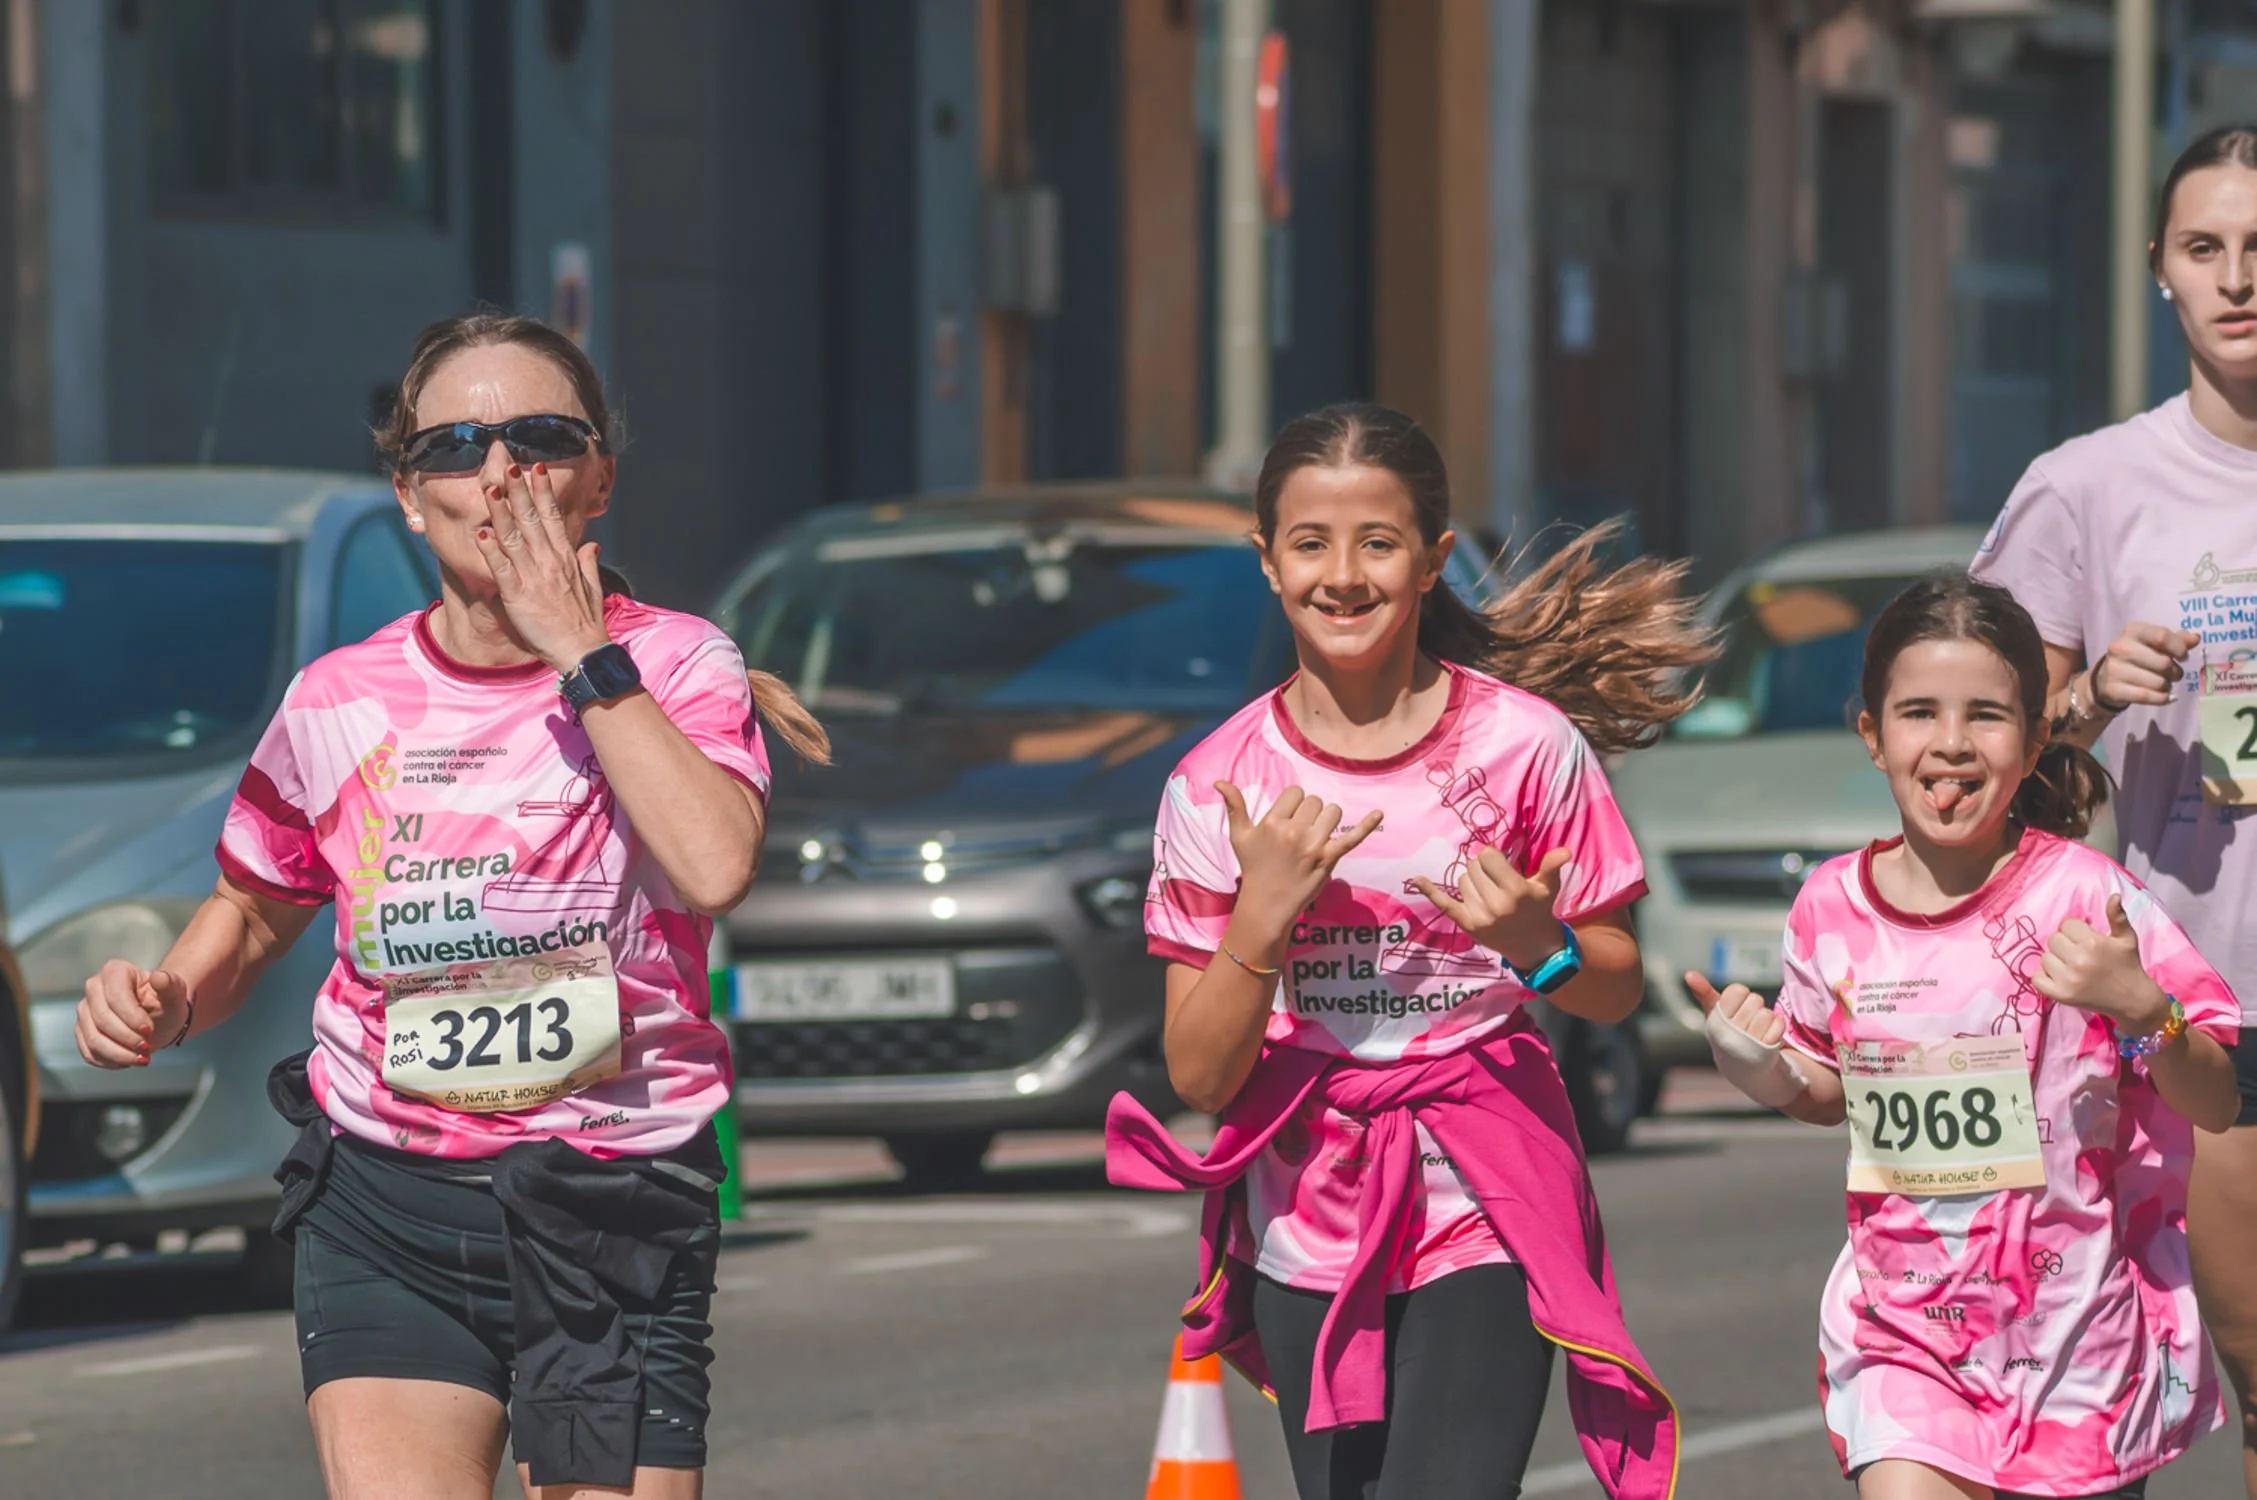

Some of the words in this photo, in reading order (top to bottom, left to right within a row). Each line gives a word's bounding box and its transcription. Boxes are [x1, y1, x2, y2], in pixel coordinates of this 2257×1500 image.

[2179, 596, 2207, 612] VIII
[2181, 616, 2202, 629] de
[2208, 611, 2224, 626] la
[404, 747, 457, 758] asociación
[459, 747, 508, 759] española
[403, 761, 435, 771] contra
[437, 760, 446, 770] el
[449, 760, 485, 770] cáncer
[402, 774, 415, 784] en
[416, 773, 429, 783] La
[431, 773, 457, 786] Rioja
[389, 813, 424, 843] XI
[384, 852, 512, 883] Carrera
[347, 806, 386, 970] mujer
[380, 899, 436, 934] por
[443, 891, 476, 922] la
[384, 916, 608, 967] Investigación
[1291, 922, 1406, 946] Carrera
[411, 974, 451, 984] Carrera
[452, 973, 470, 983] por
[471, 971, 482, 980] la
[1293, 958, 1341, 986] por
[1349, 954, 1375, 981] la
[1859, 981, 1897, 991] asociación
[1899, 977, 1938, 989] española
[1881, 991, 1889, 1000] el
[1890, 991, 1919, 1000] cáncer
[1867, 1004, 1875, 1013] La
[1876, 1003, 1896, 1014] Rioja
[426, 997, 574, 1071] 3213
[1857, 1053, 1881, 1063] Carrera
[1883, 1056, 1896, 1064] por
[464, 1089, 510, 1103] NATUR
[514, 1083, 560, 1100] HOUSE
[1865, 1086, 2002, 1152] 2968
[1904, 1173, 1936, 1184] NATUR
[1939, 1171, 1980, 1184] HOUSE
